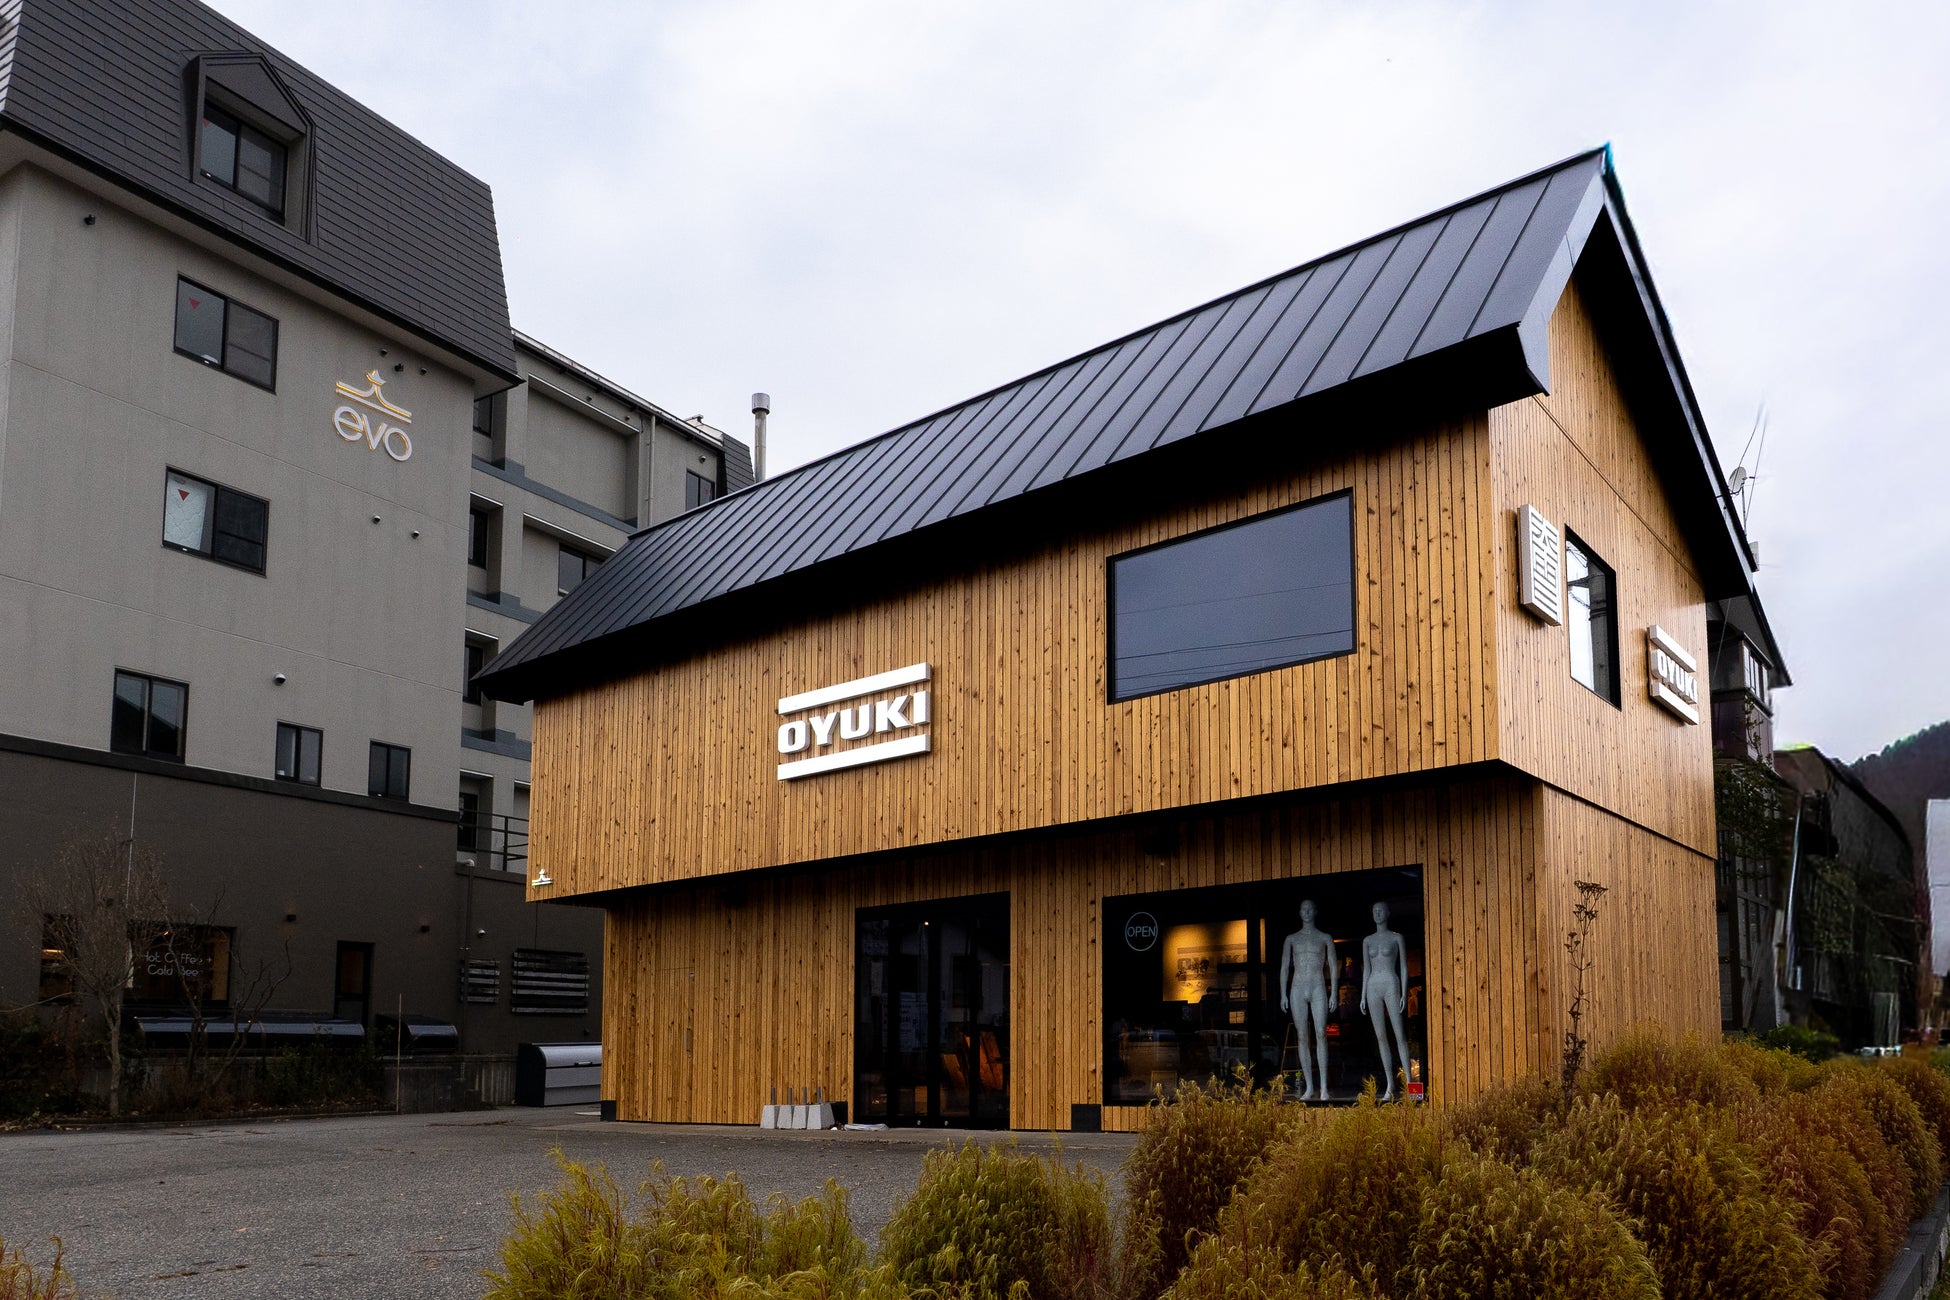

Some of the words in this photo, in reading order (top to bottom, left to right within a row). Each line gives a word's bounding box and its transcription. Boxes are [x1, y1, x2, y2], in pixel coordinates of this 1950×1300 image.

[333, 406, 412, 461] evo
[1652, 648, 1697, 704] OYUKI
[778, 690, 930, 754] OYUKI
[1127, 926, 1156, 937] OPEN
